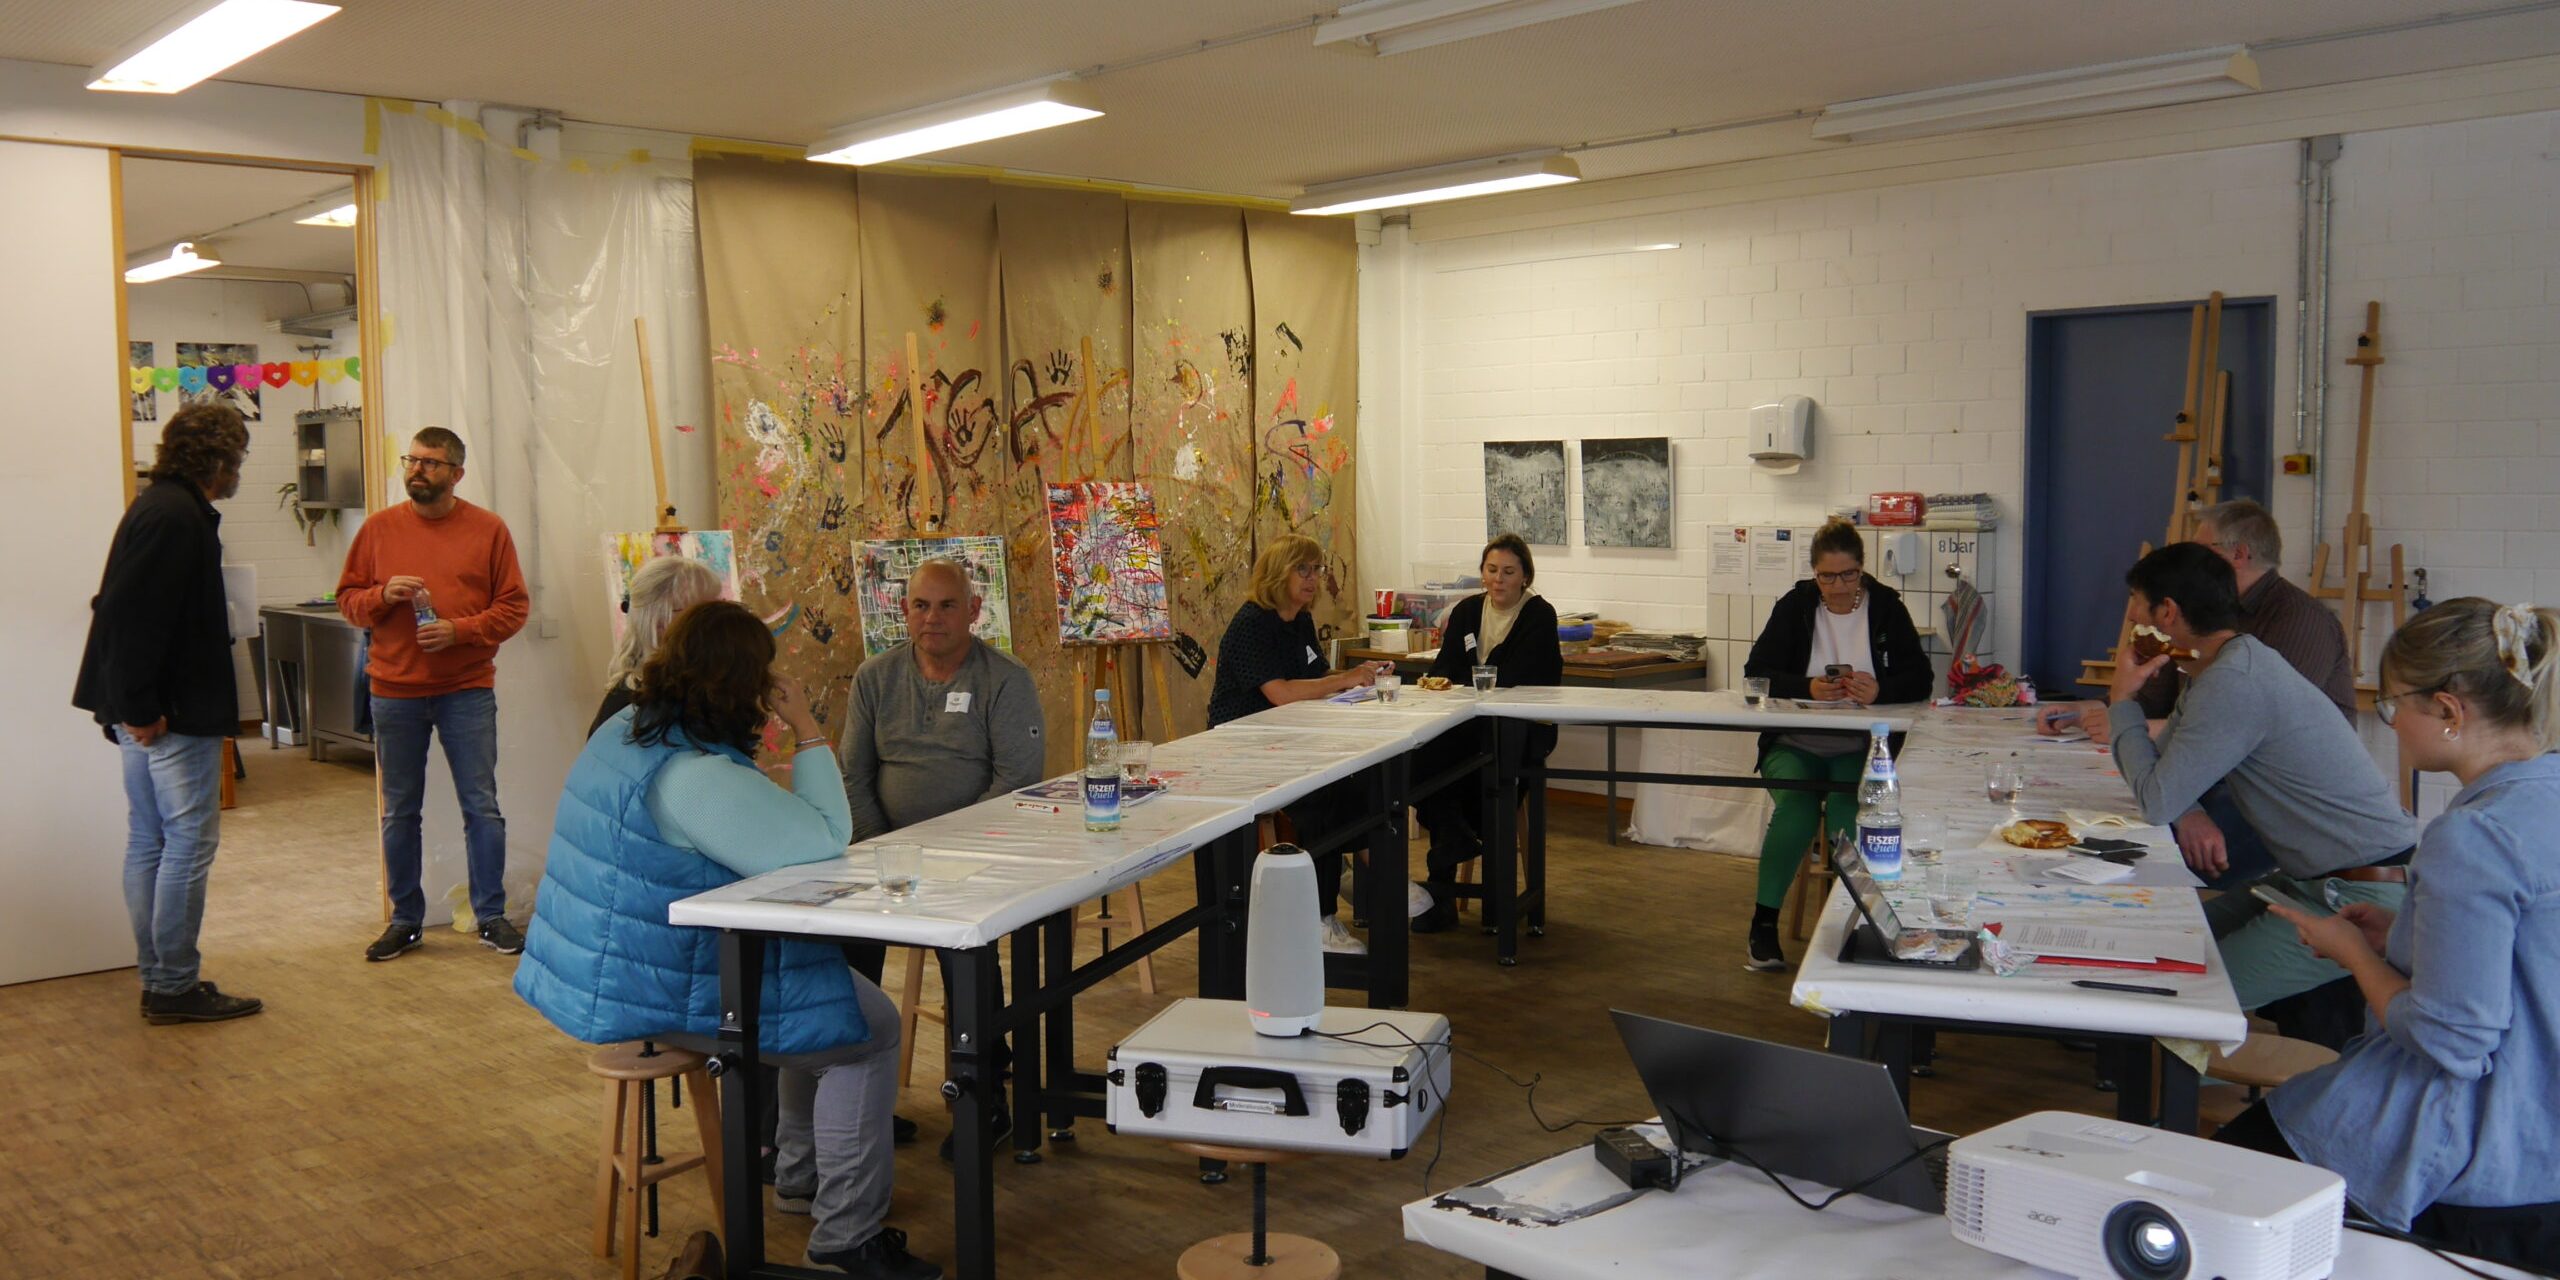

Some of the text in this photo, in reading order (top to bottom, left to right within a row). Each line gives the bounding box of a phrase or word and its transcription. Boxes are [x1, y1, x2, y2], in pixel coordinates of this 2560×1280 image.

[1939, 537, 1975, 553] 8 bar
[1088, 784, 1116, 792] EISZEIT
[1867, 835, 1900, 845] EISZEIT
[2026, 1209, 2062, 1226] acer
